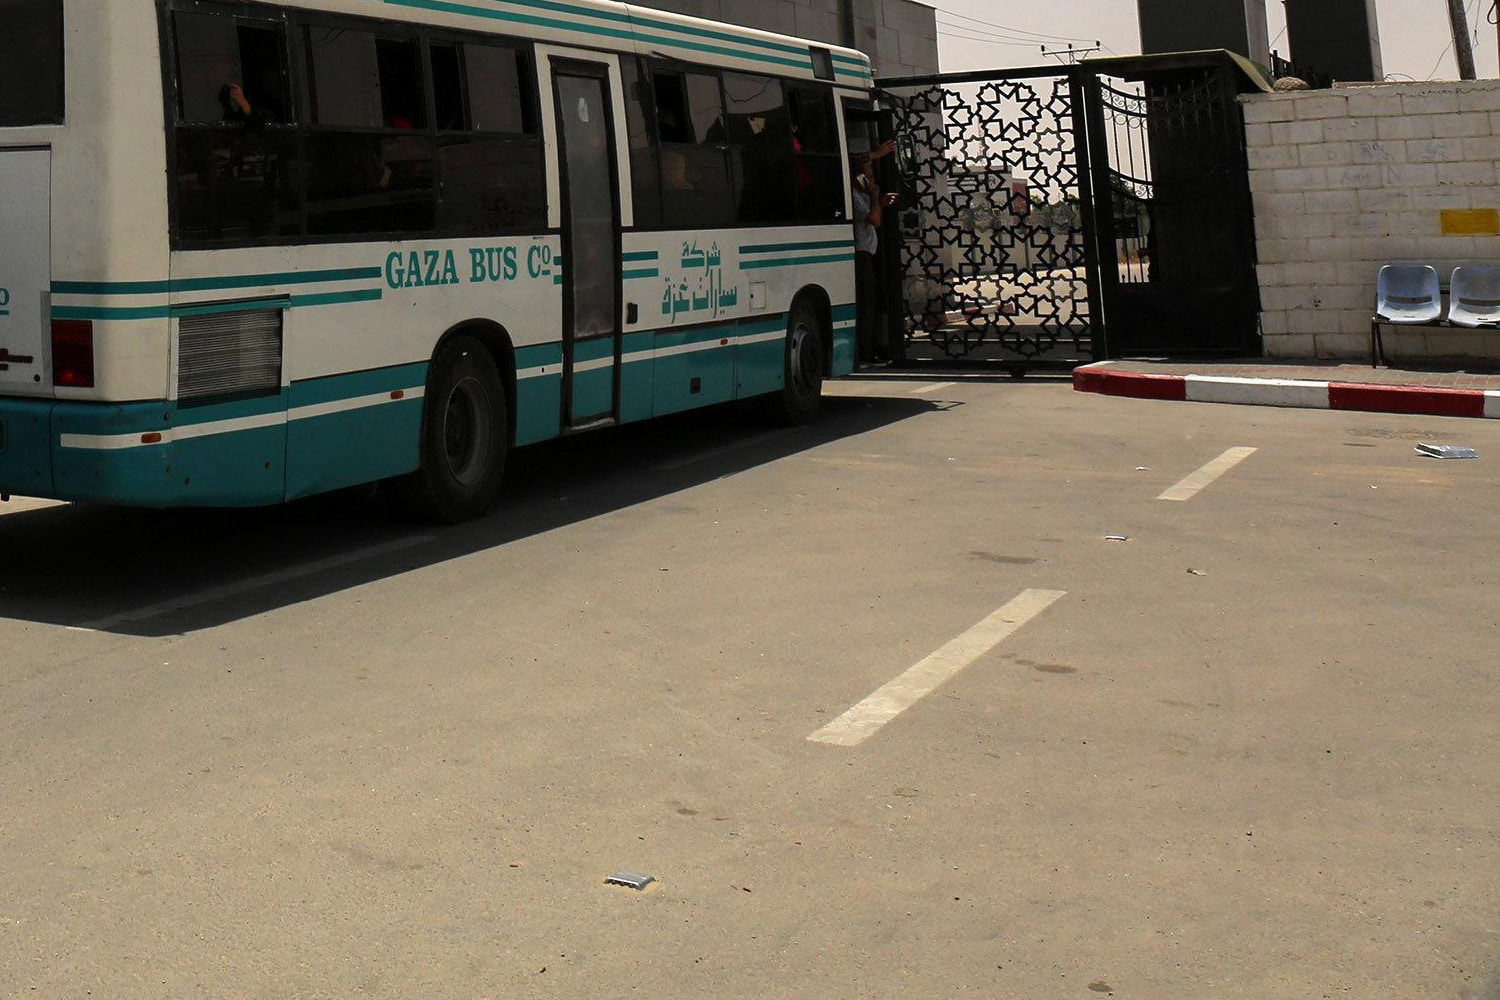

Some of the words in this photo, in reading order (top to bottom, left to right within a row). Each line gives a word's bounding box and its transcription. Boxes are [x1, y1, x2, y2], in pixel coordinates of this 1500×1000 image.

[385, 250, 460, 290] GAZA
[468, 245, 518, 283] BUS
[681, 237, 722, 278] شركة
[661, 277, 691, 325] غزة
[693, 268, 738, 319] سيارات
